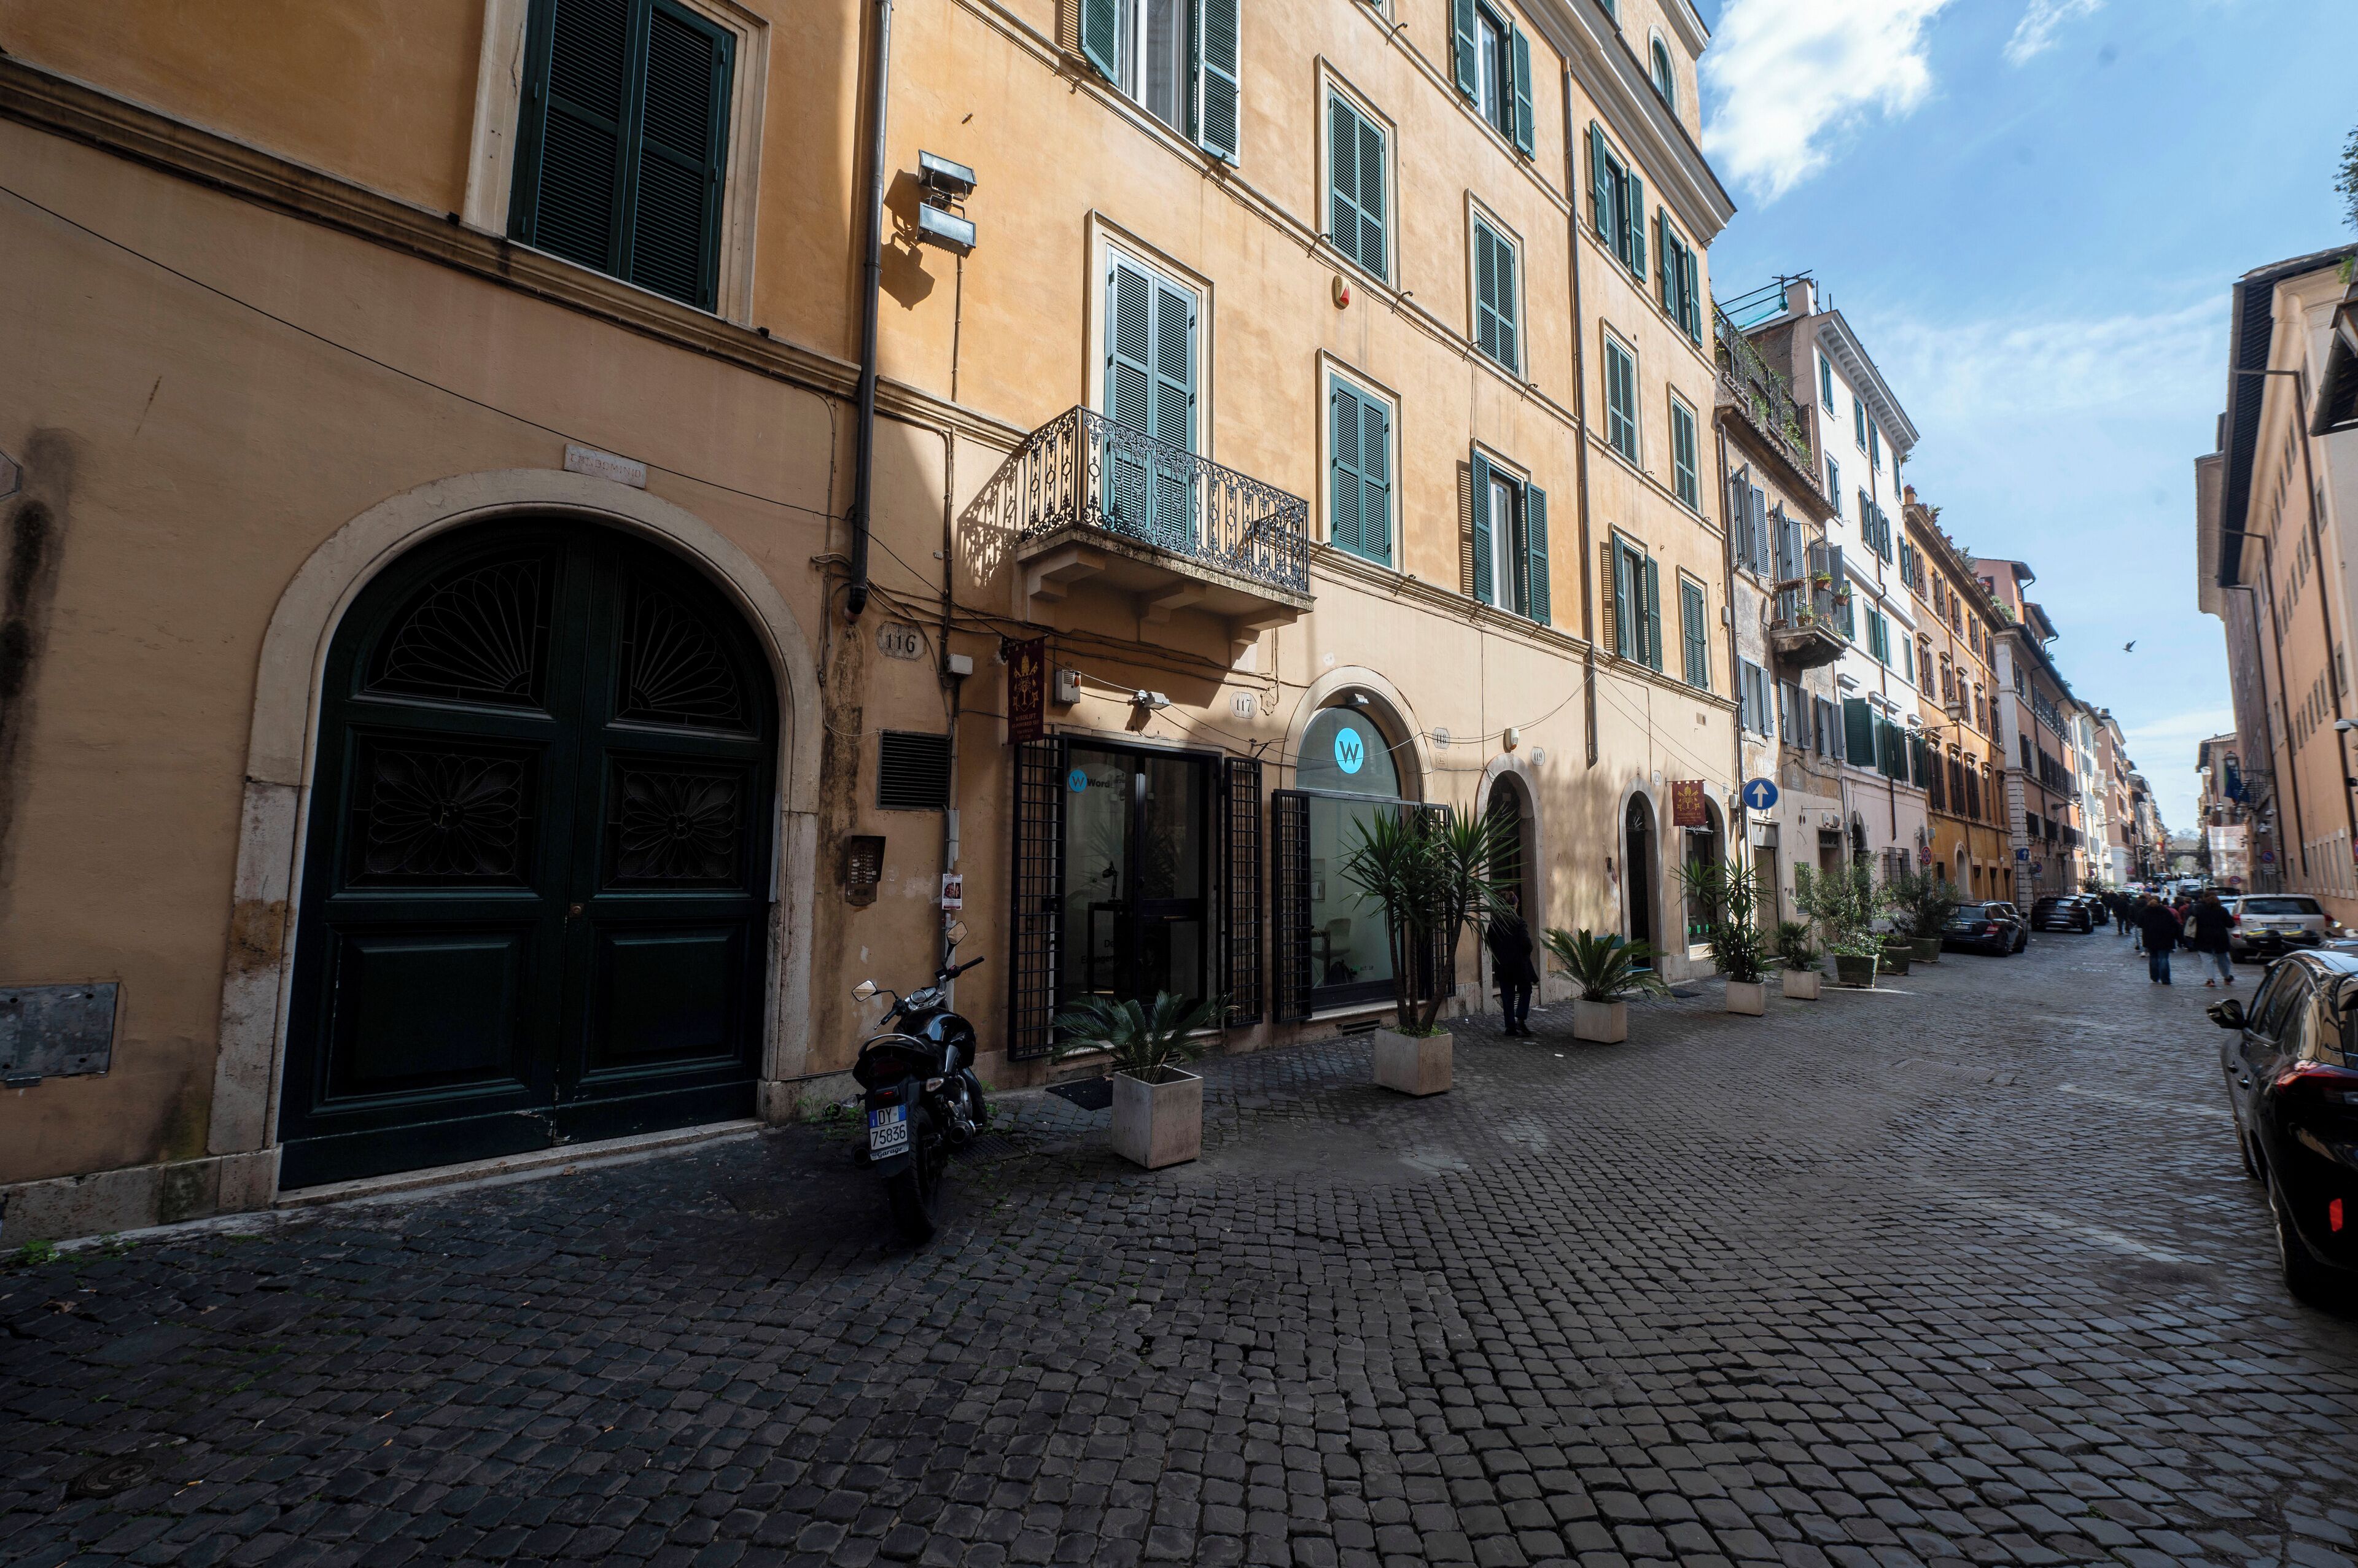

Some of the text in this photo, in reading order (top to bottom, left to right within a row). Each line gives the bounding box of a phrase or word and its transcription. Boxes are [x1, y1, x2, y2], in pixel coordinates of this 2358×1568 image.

[569, 454, 641, 478] CONDOMINIO
[886, 634, 916, 653] 116
[1237, 698, 1251, 712] 117
[1339, 740, 1360, 764] W
[1534, 752, 1543, 761] 119
[878, 1108, 892, 1125] DY
[872, 1124, 906, 1147] 75836
[877, 1147, 903, 1158] Garage
